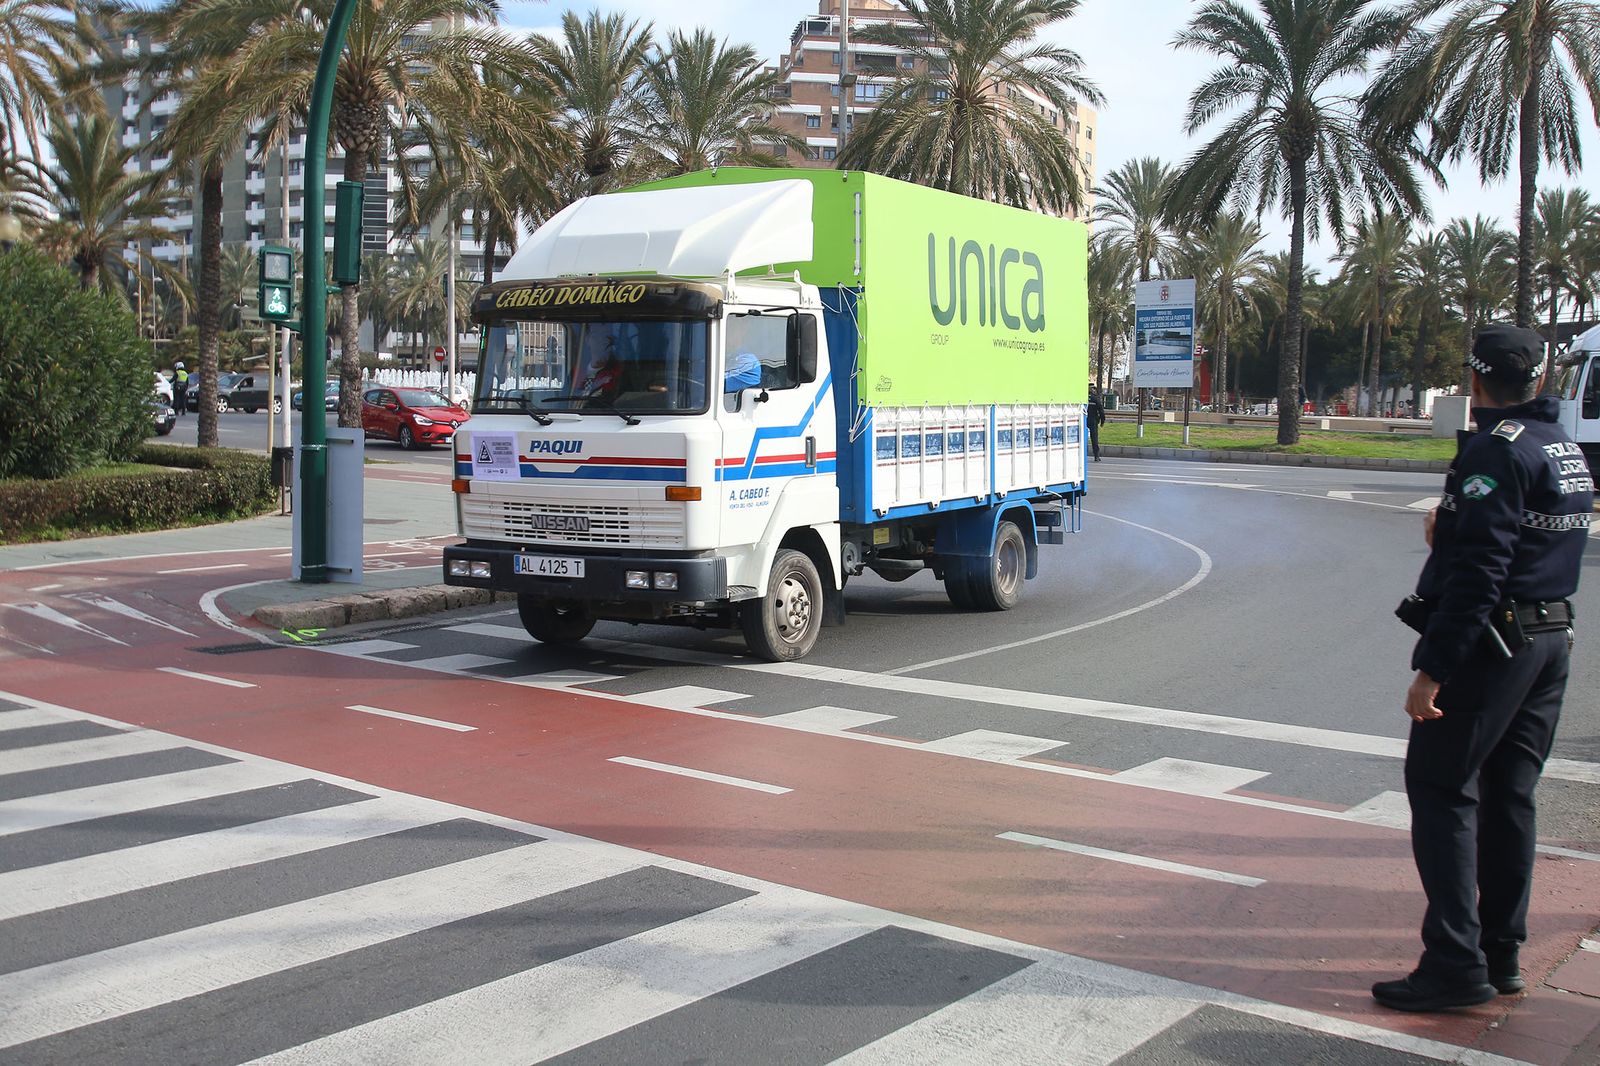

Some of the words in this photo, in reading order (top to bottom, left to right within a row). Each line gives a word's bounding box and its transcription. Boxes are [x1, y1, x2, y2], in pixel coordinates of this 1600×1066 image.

[496, 286, 554, 309] CABEO
[554, 284, 646, 305] DOMINGO
[930, 333, 949, 346] GROUP
[530, 440, 583, 455] PAQUI
[1556, 459, 1589, 475] LOCAL
[739, 487, 764, 500] CABEO
[532, 515, 589, 531] NISSAN
[521, 558, 534, 573] AL
[540, 559, 568, 575] 4125
[574, 561, 582, 576] T
